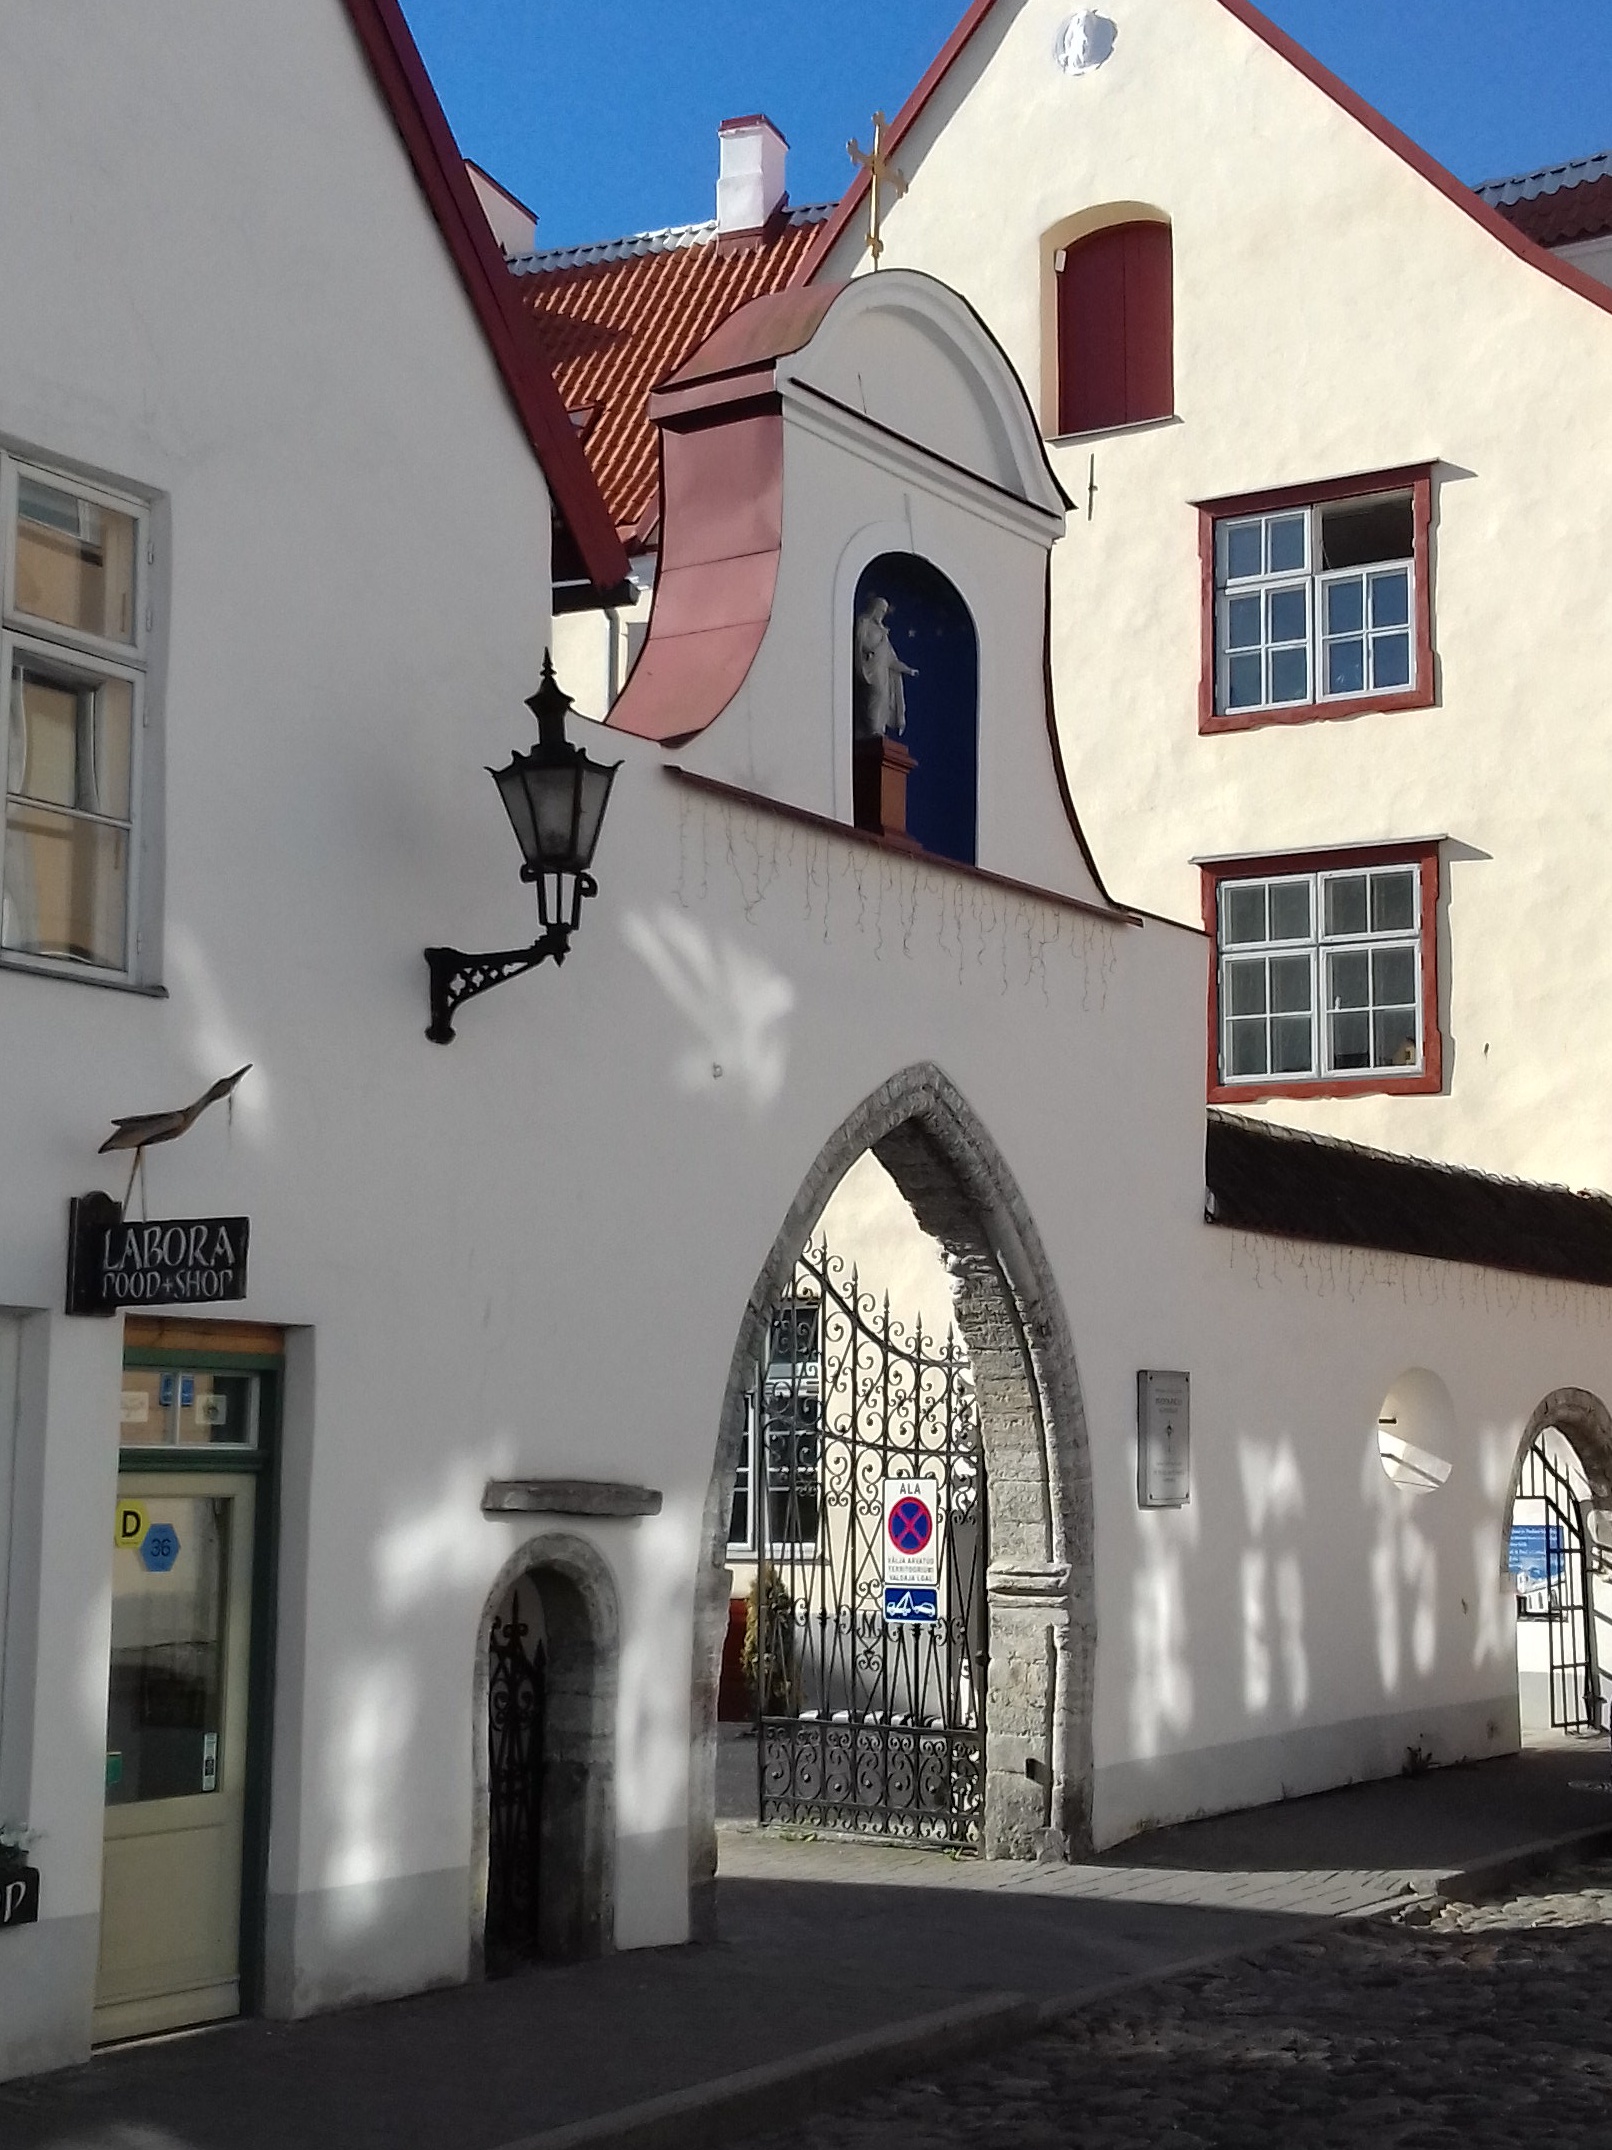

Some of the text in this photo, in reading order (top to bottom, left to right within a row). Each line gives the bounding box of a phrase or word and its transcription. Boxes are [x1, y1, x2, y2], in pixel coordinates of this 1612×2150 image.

[103, 1225, 236, 1271] LABORA
[900, 1482, 921, 1494] ALA
[122, 1510, 141, 1538] D
[151, 1538, 171, 1557] 36
